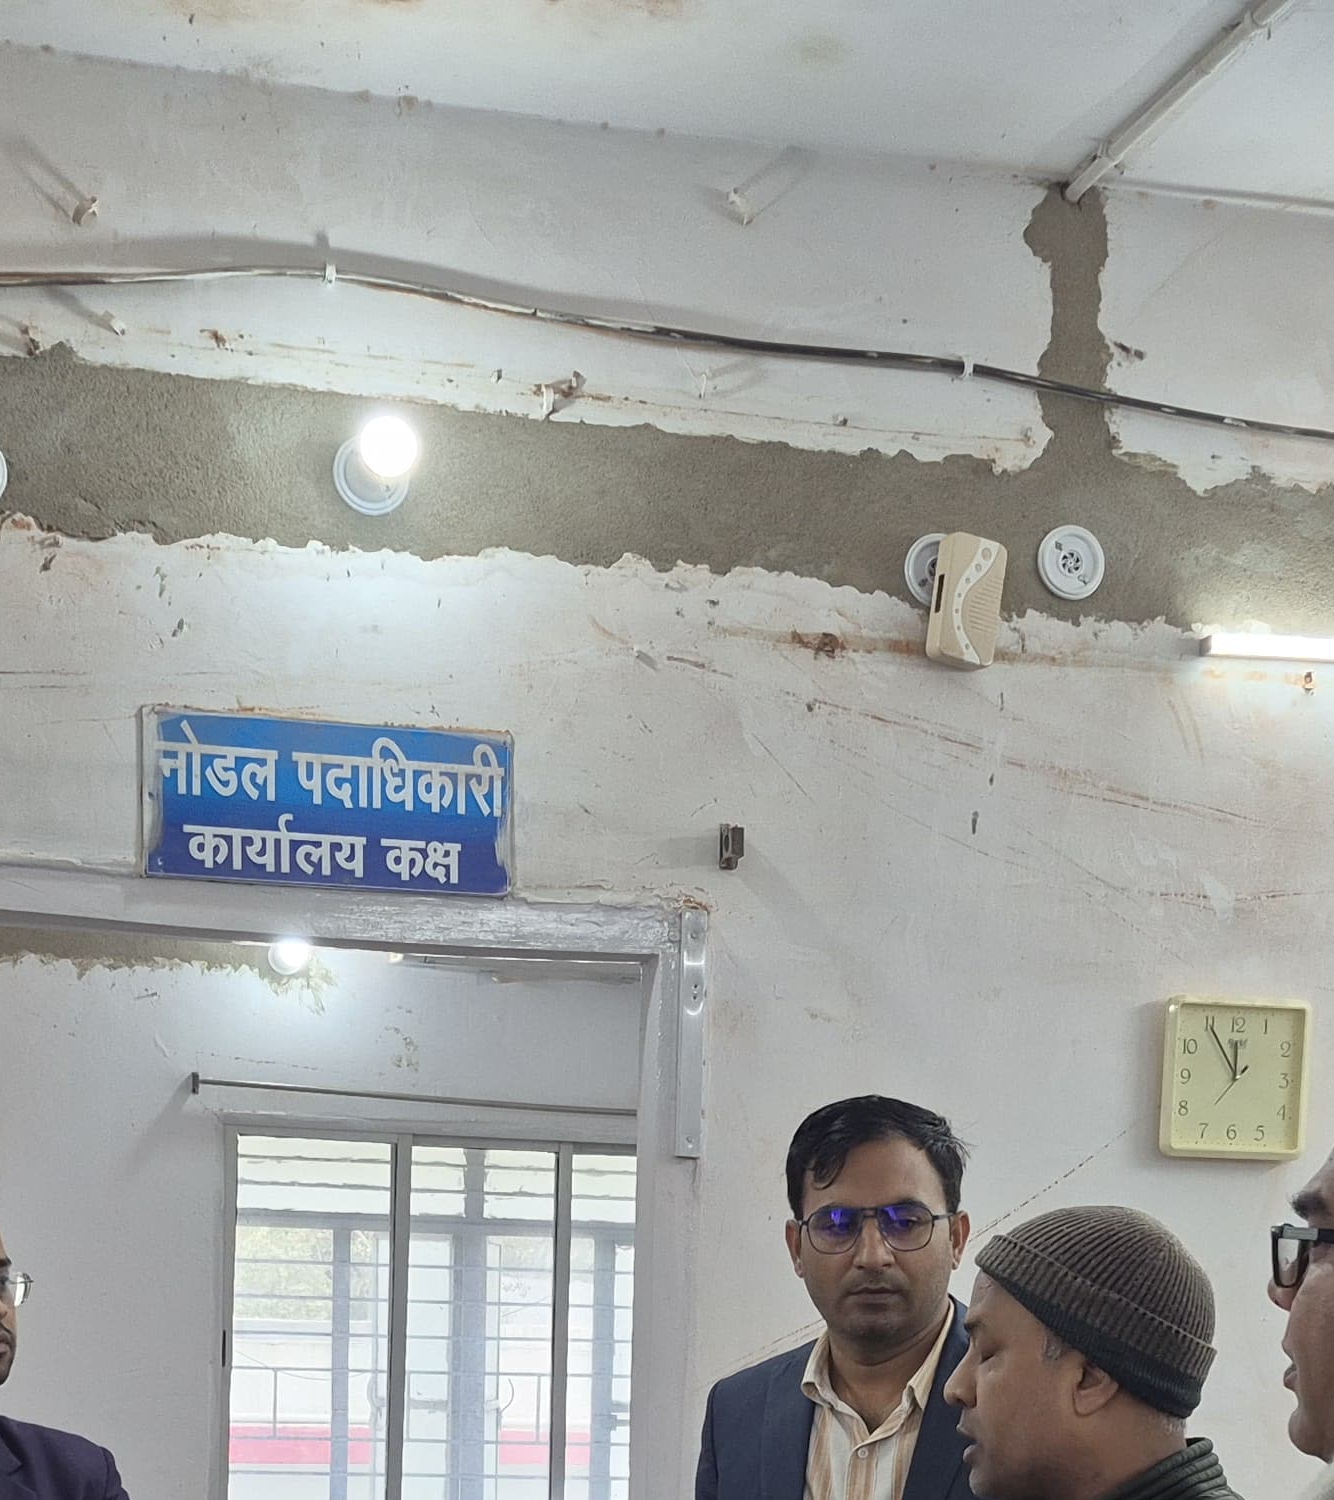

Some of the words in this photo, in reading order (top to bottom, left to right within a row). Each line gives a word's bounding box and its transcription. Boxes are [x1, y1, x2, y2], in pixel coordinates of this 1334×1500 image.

[155, 719, 279, 802] नोडल
[291, 736, 506, 818] पदाधिकारी
[182, 813, 367, 878] कार्यालय
[380, 838, 462, 884] कक्ष
[1231, 1016, 1246, 1033] 12
[1182, 1038, 1198, 1055] 10
[1279, 1041, 1292, 1058] 2
[1179, 1068, 1191, 1085] 9
[1278, 1072, 1289, 1089] 3
[1177, 1100, 1189, 1117] 8
[1276, 1104, 1286, 1121] 4
[1199, 1122, 1209, 1139] 7
[1226, 1124, 1237, 1140] 6
[1254, 1125, 1265, 1142] 5
